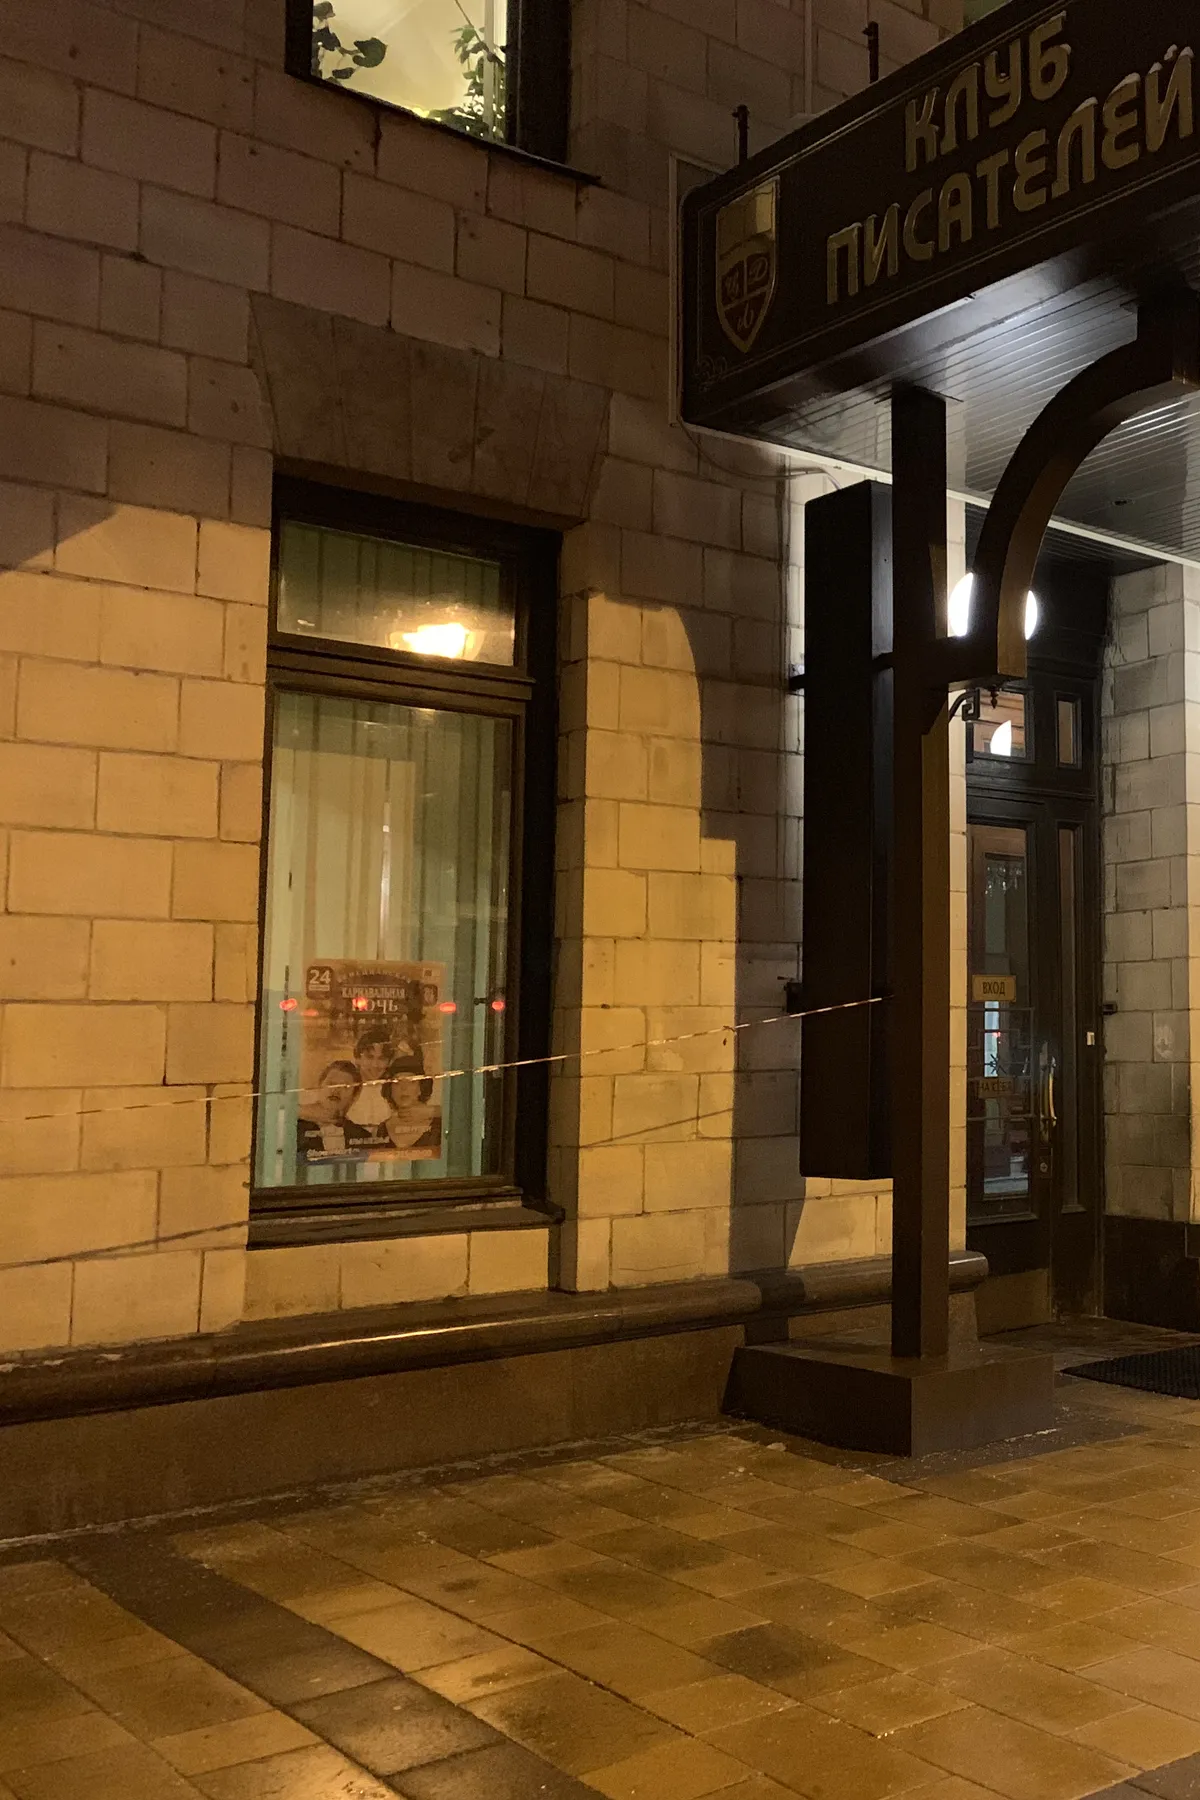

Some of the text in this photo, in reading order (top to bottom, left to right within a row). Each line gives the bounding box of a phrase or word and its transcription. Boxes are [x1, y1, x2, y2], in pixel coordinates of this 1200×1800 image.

[905, 10, 1072, 173] КЛУБ
[826, 44, 1196, 305] ПИСАТЕЛЕЙ
[309, 969, 331, 984] 24
[342, 987, 405, 998] КАРНАВАЛЬНАЯ
[982, 981, 1005, 996] ВХОД
